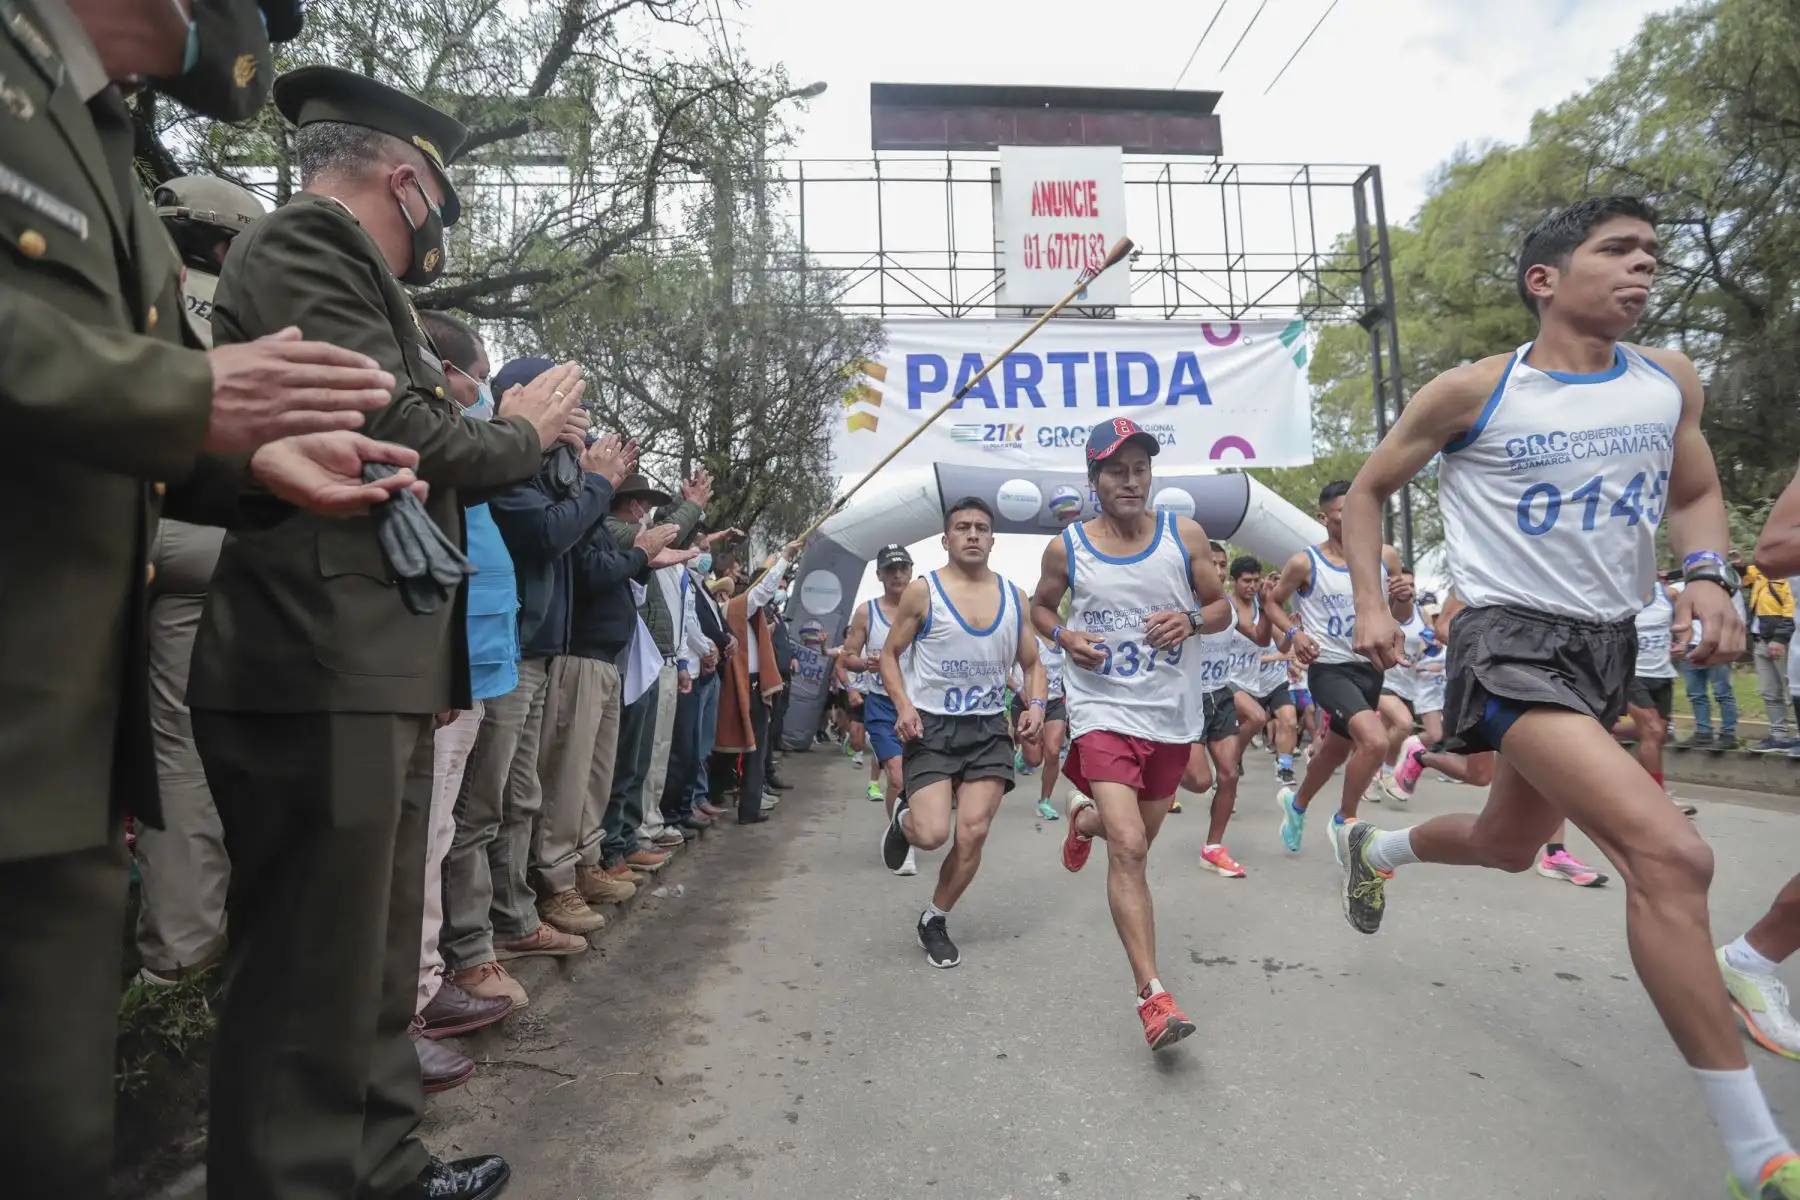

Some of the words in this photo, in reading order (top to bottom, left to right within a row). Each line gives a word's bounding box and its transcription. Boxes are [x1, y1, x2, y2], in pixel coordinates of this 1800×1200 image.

[1031, 180, 1099, 217] ANUNCIE
[1023, 233, 1107, 270] 01-6717183
[905, 350, 1213, 410] PARTIDA
[1505, 431, 1568, 458] GRC
[1569, 424, 1632, 443] GOBIERNO
